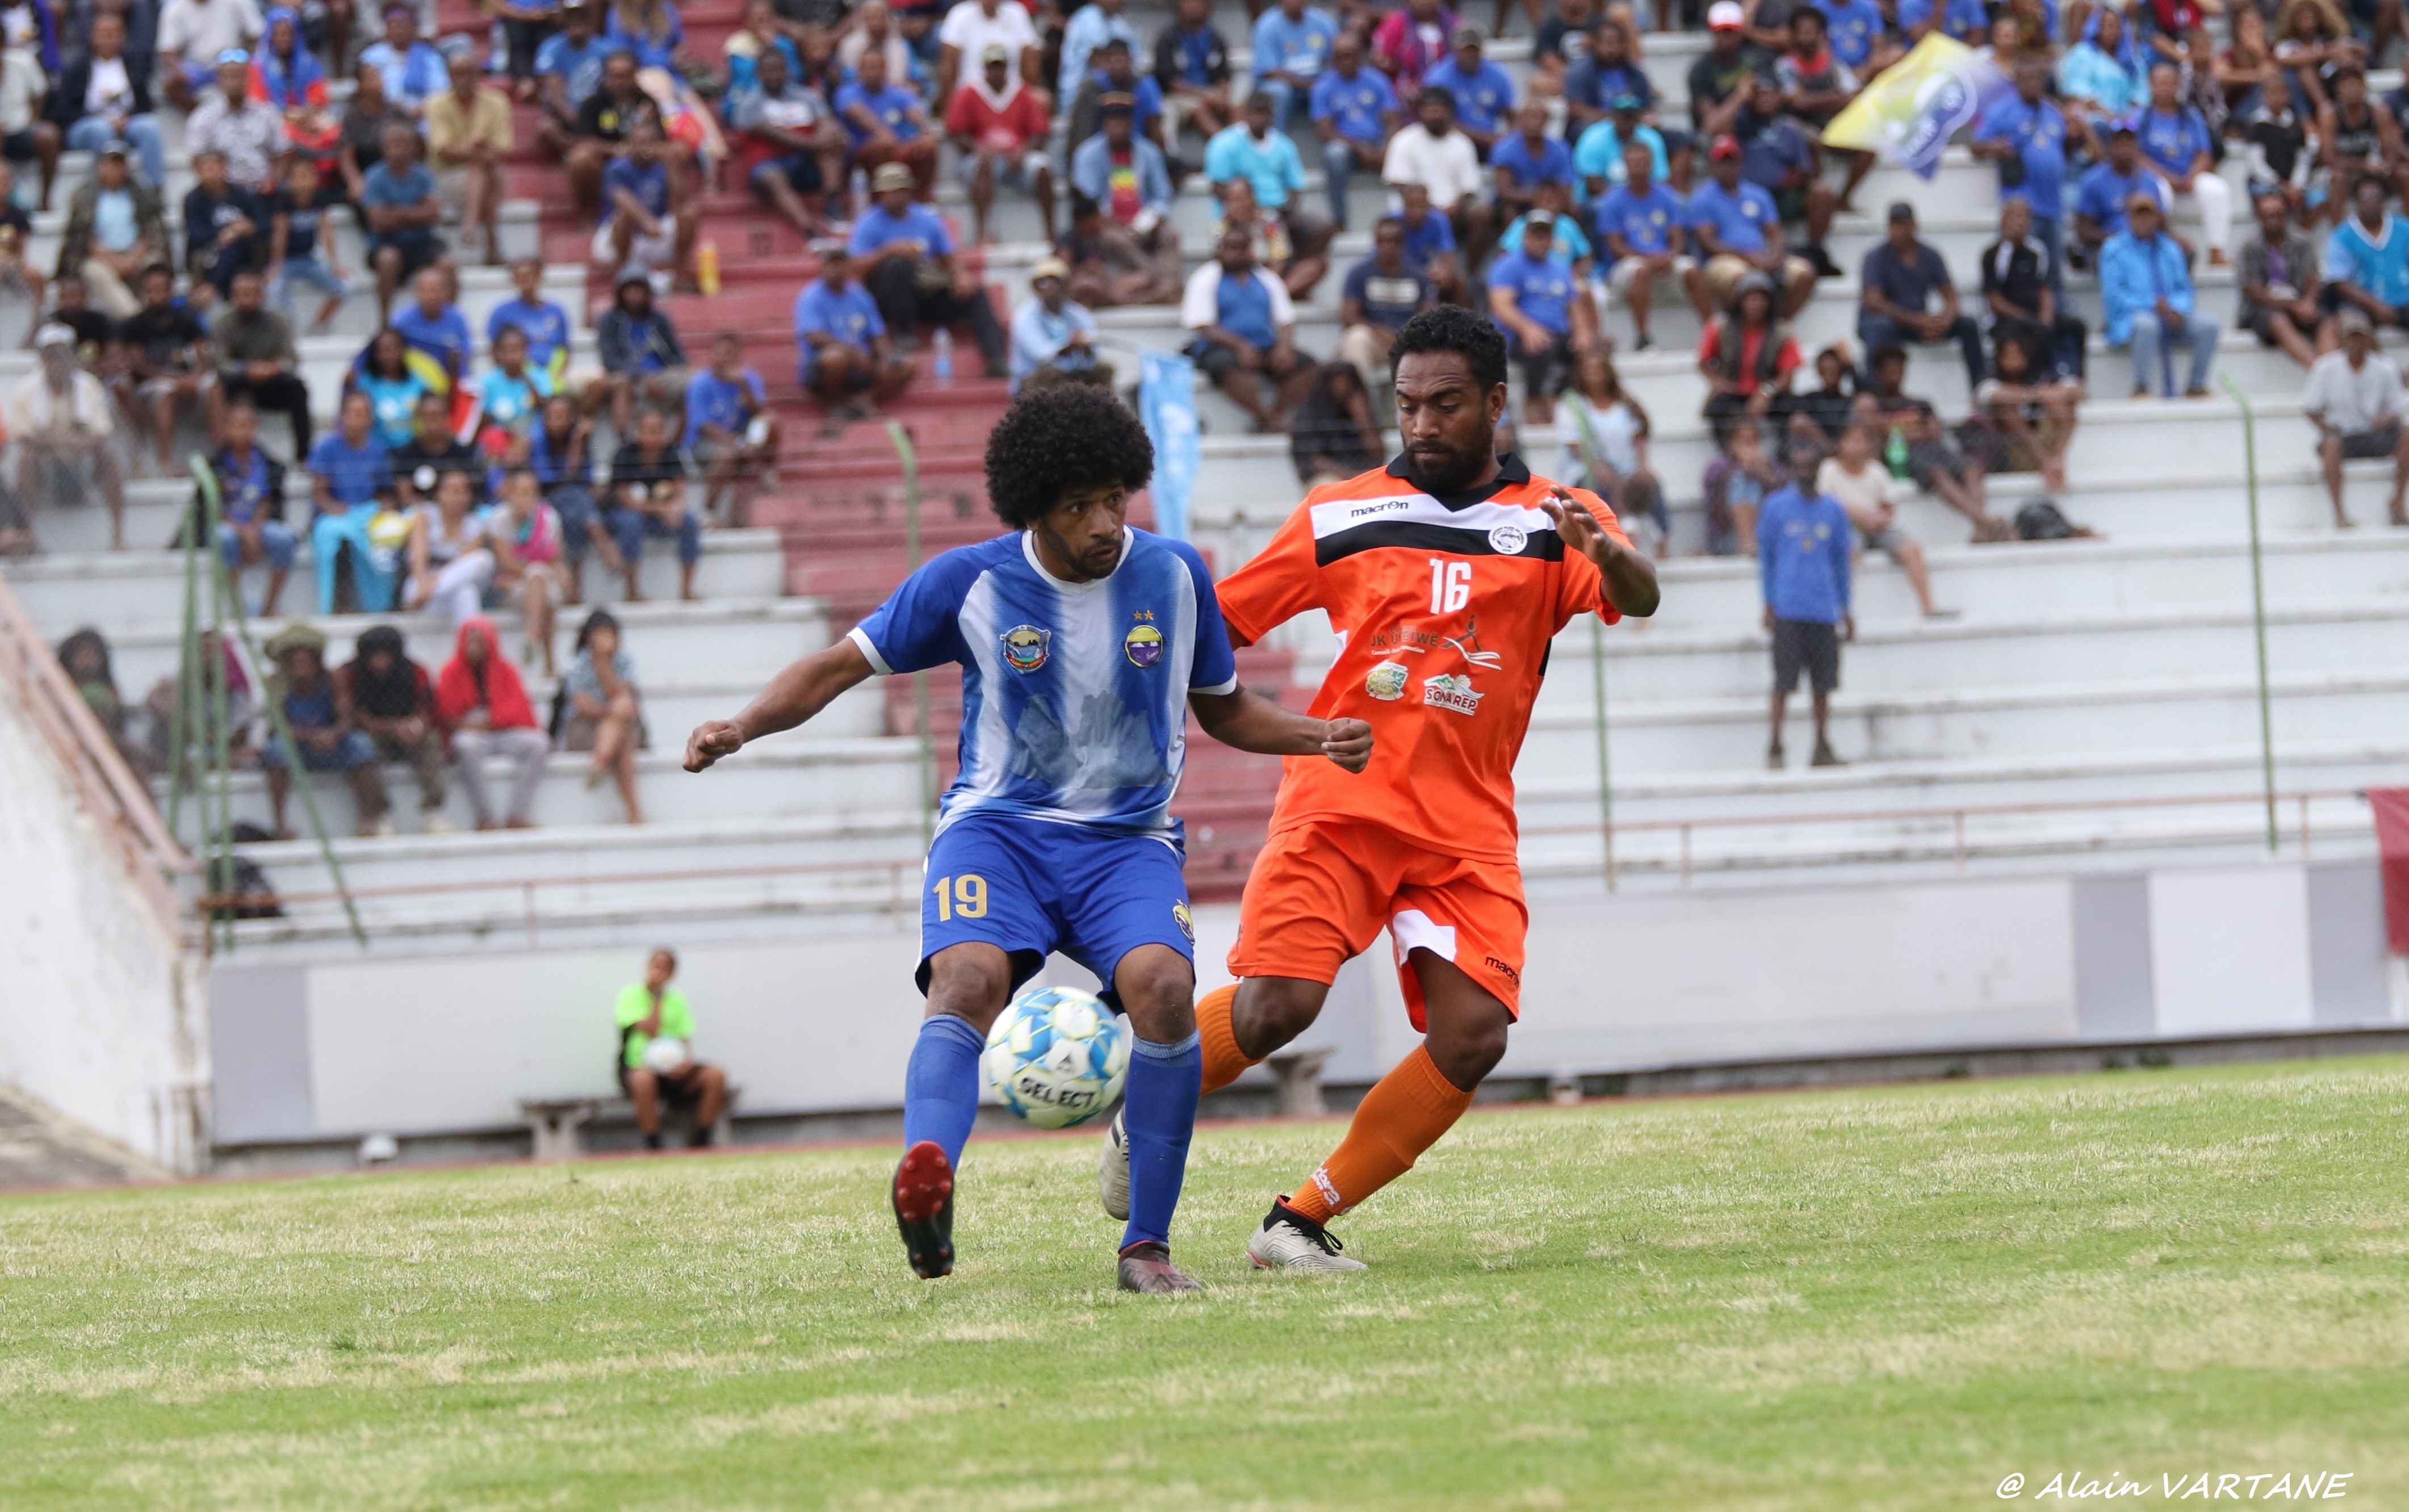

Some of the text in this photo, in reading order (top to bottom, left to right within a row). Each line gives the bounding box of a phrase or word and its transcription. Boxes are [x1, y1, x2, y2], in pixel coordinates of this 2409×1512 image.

[1351, 501, 1409, 518] macron
[1429, 559, 1472, 615] 16
[1426, 688, 1477, 709] SONAREP
[932, 874, 988, 923] 19
[1021, 1077, 1096, 1108] SELECT
